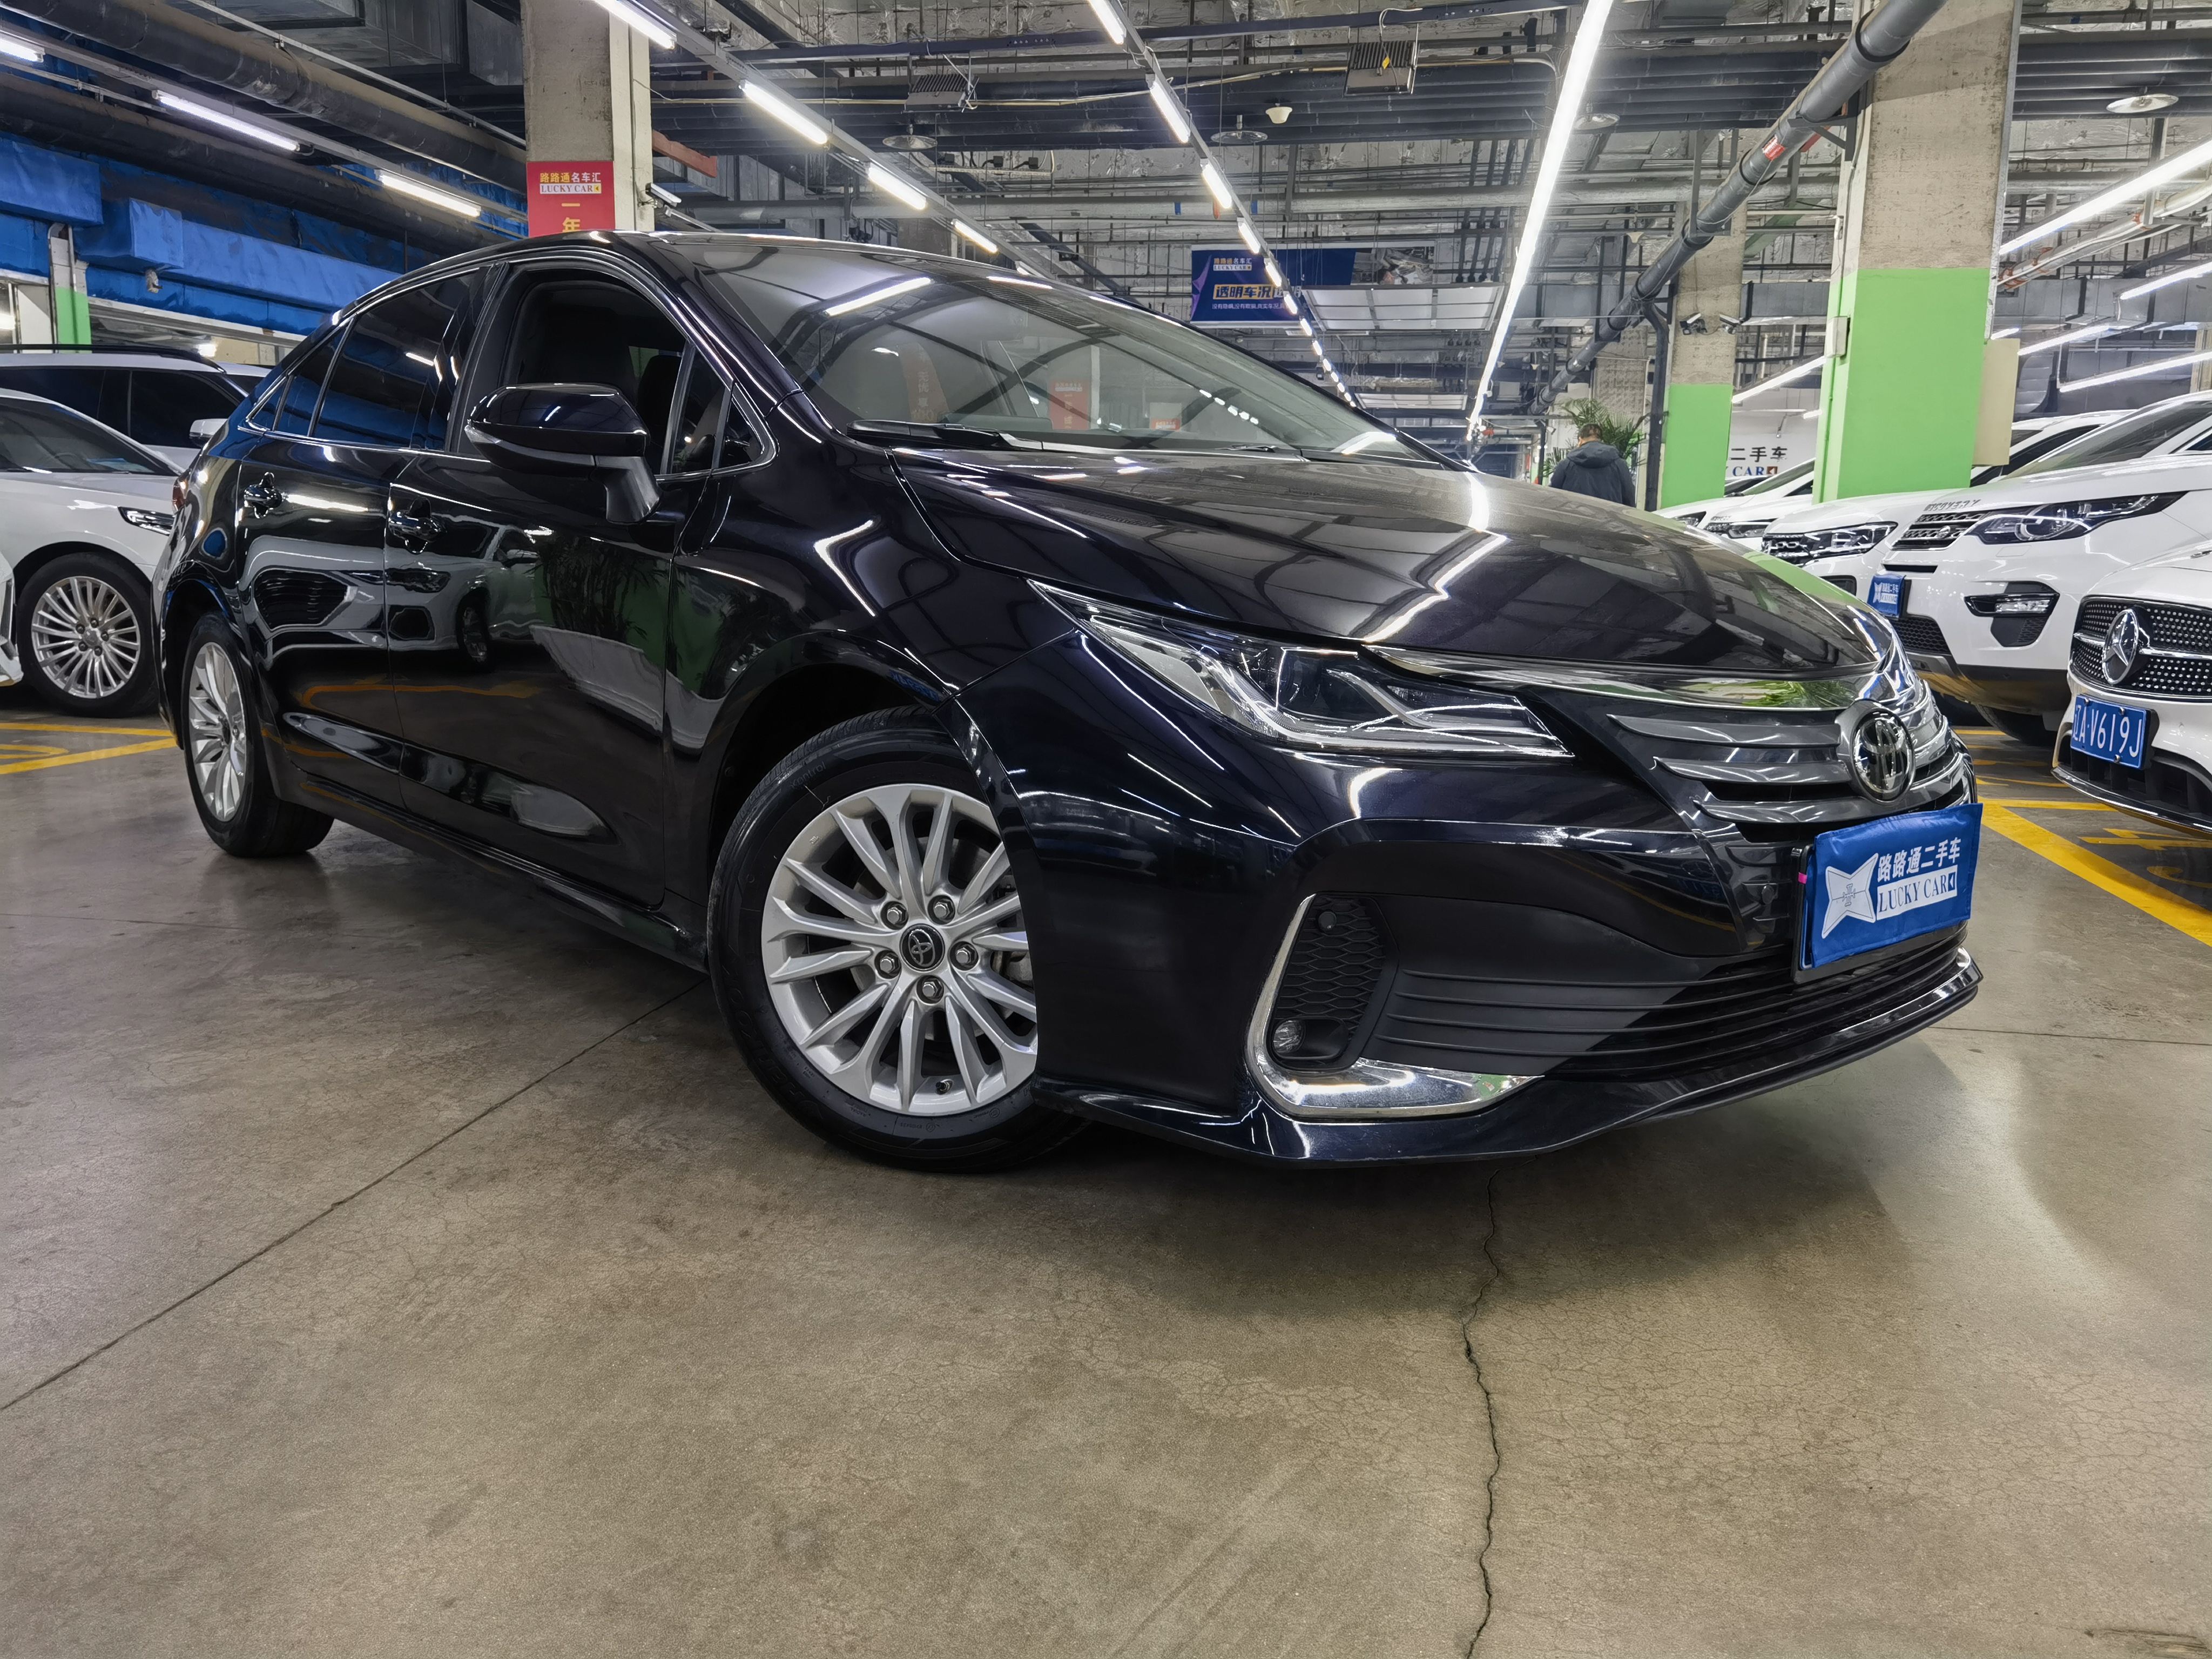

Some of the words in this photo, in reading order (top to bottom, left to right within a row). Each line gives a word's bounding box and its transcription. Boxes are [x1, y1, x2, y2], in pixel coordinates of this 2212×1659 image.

[540, 172, 601, 183] 路路通名车汇
[1216, 286, 1273, 298] 透明车况
[1729, 447, 1788, 462] 二手车
[1732, 466, 1764, 476] CAR
[1877, 837, 1961, 882] 路路通二手车
[1879, 881, 1921, 913] LUCKY
[1924, 874, 1947, 899] CAR
